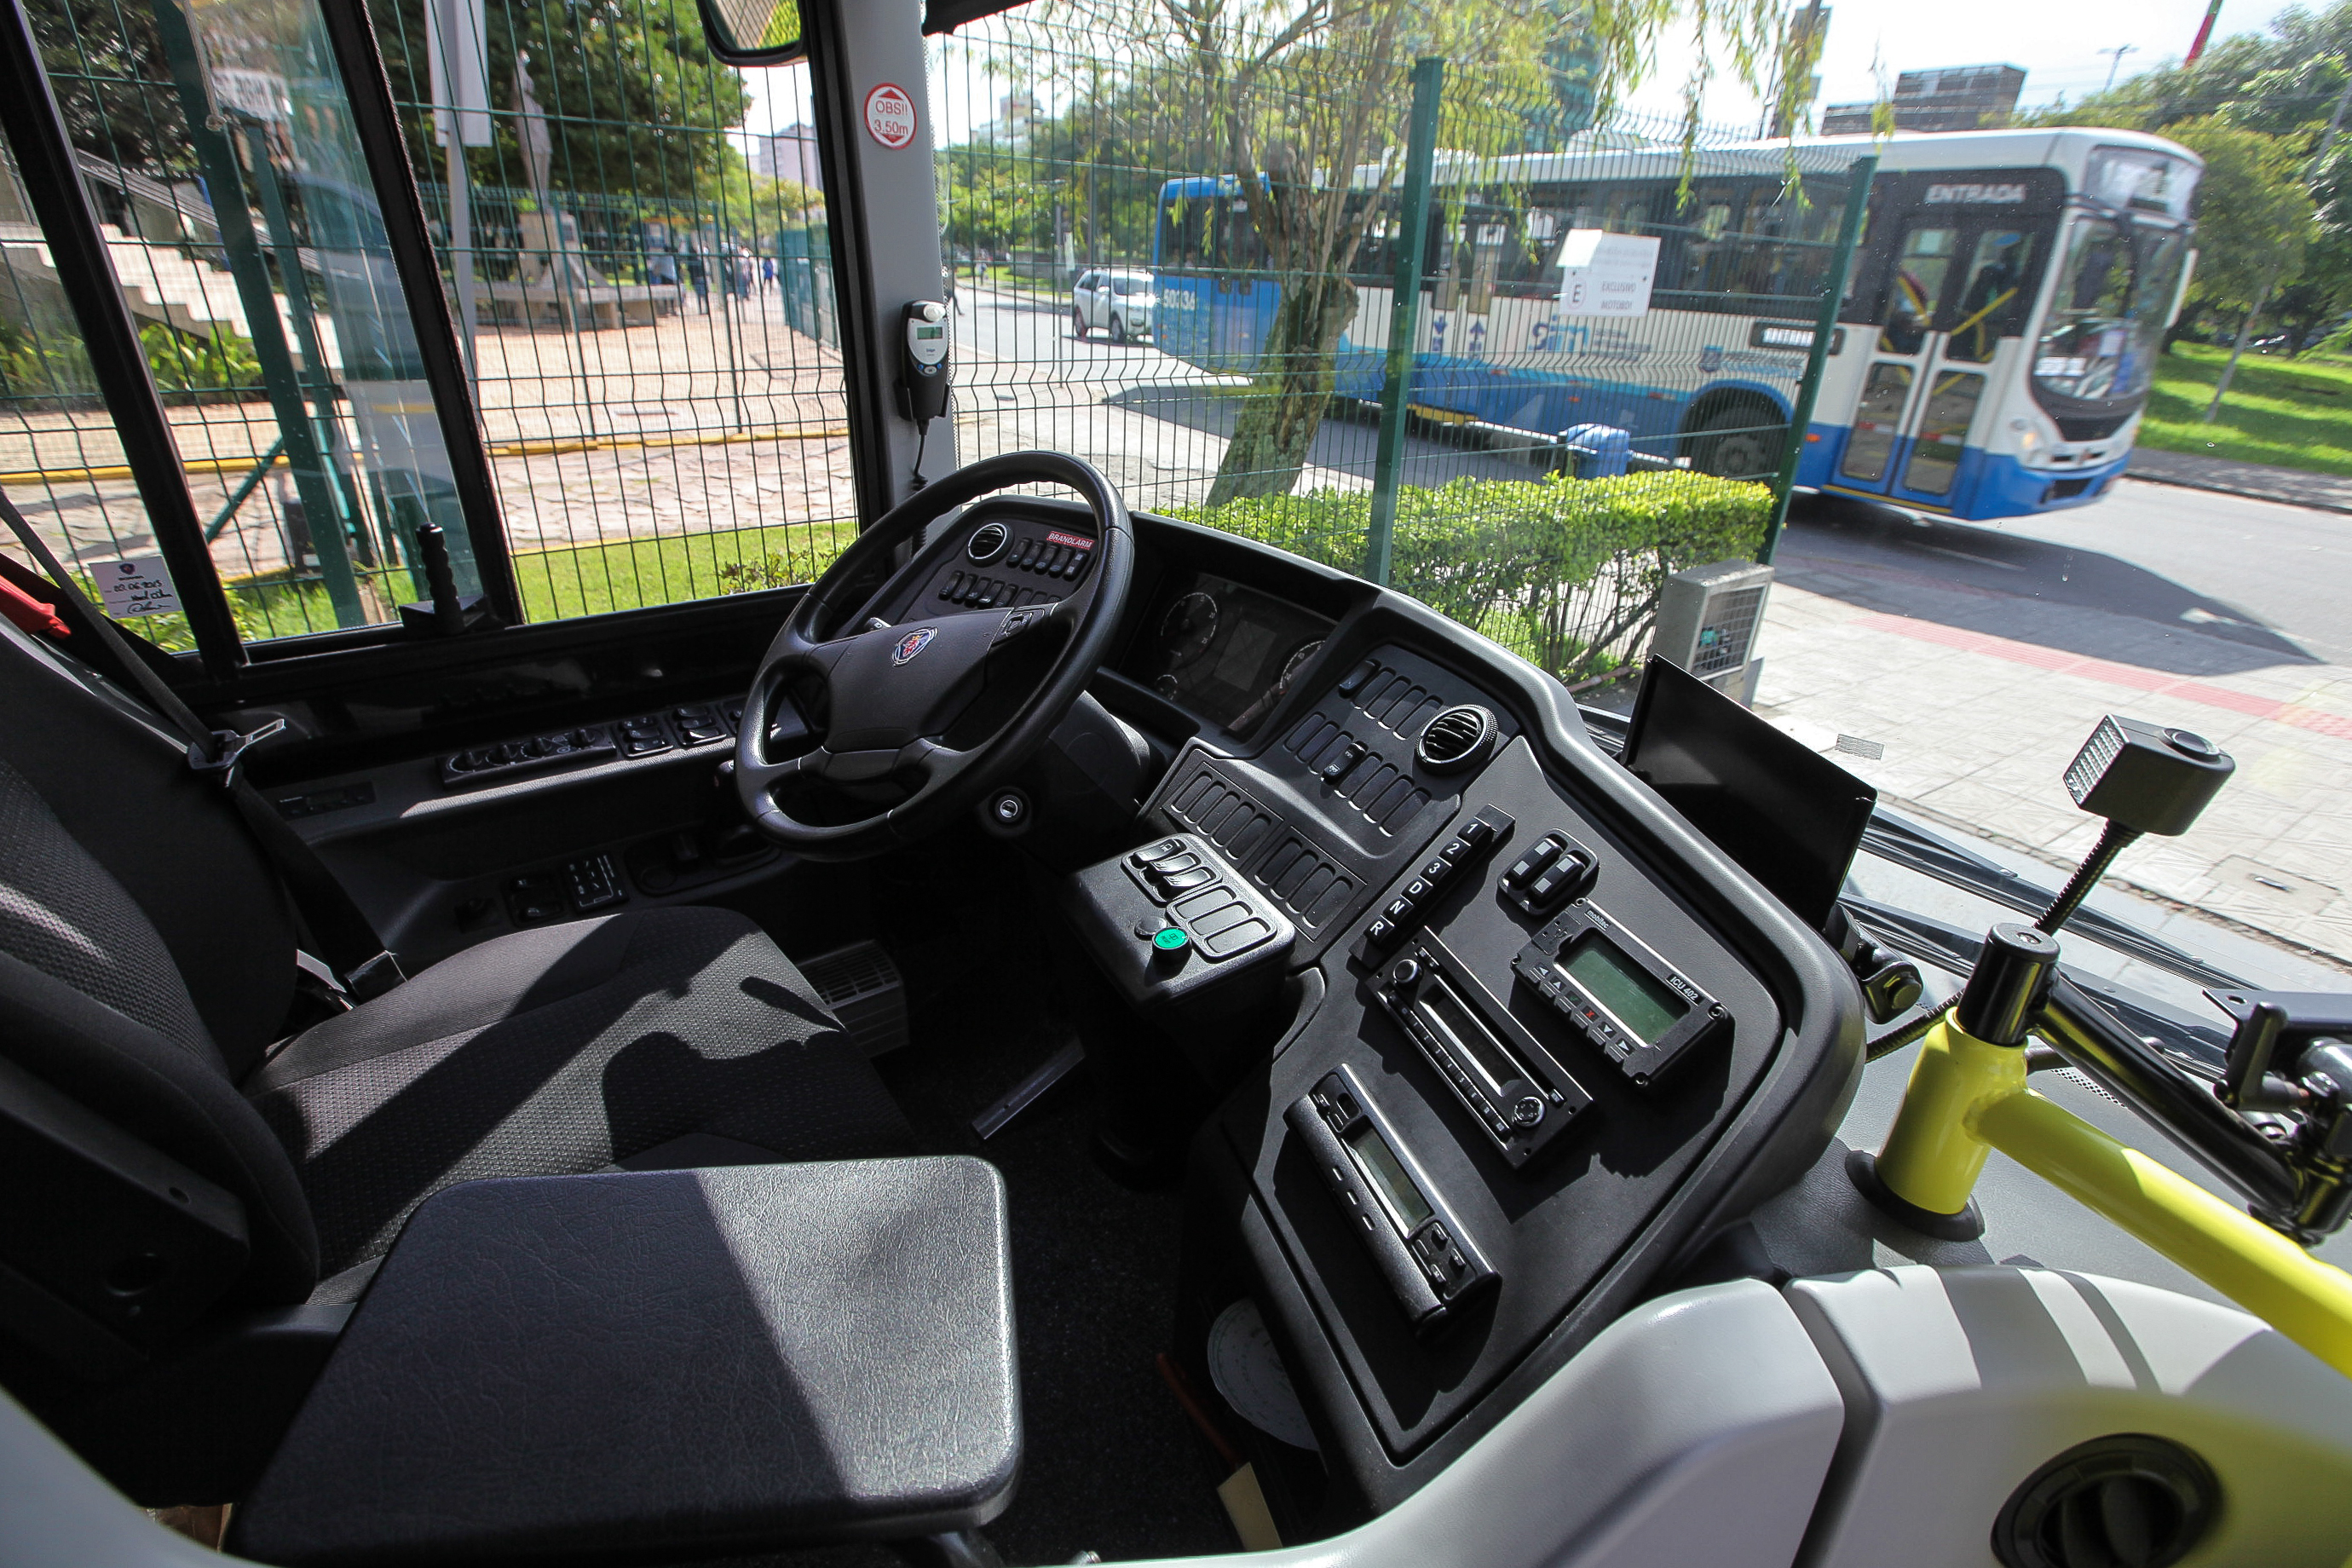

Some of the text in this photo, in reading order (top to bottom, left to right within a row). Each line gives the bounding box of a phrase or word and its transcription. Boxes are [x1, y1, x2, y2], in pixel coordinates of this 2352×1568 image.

[873, 118, 908, 135] 3.50m
[1925, 183, 2026, 204] ENTRADA
[1571, 284, 1582, 303] E
[1048, 533, 1092, 548] BRANDLARM
[1467, 822, 1479, 834] 1
[1446, 842, 1460, 855] 2
[1428, 862, 1440, 874] 3
[1409, 881, 1422, 894] D
[1389, 900, 1405, 914] N
[1587, 909, 1610, 930] mobitec
[1369, 920, 1384, 936] R
[1669, 976, 1699, 1001] ICU 402
